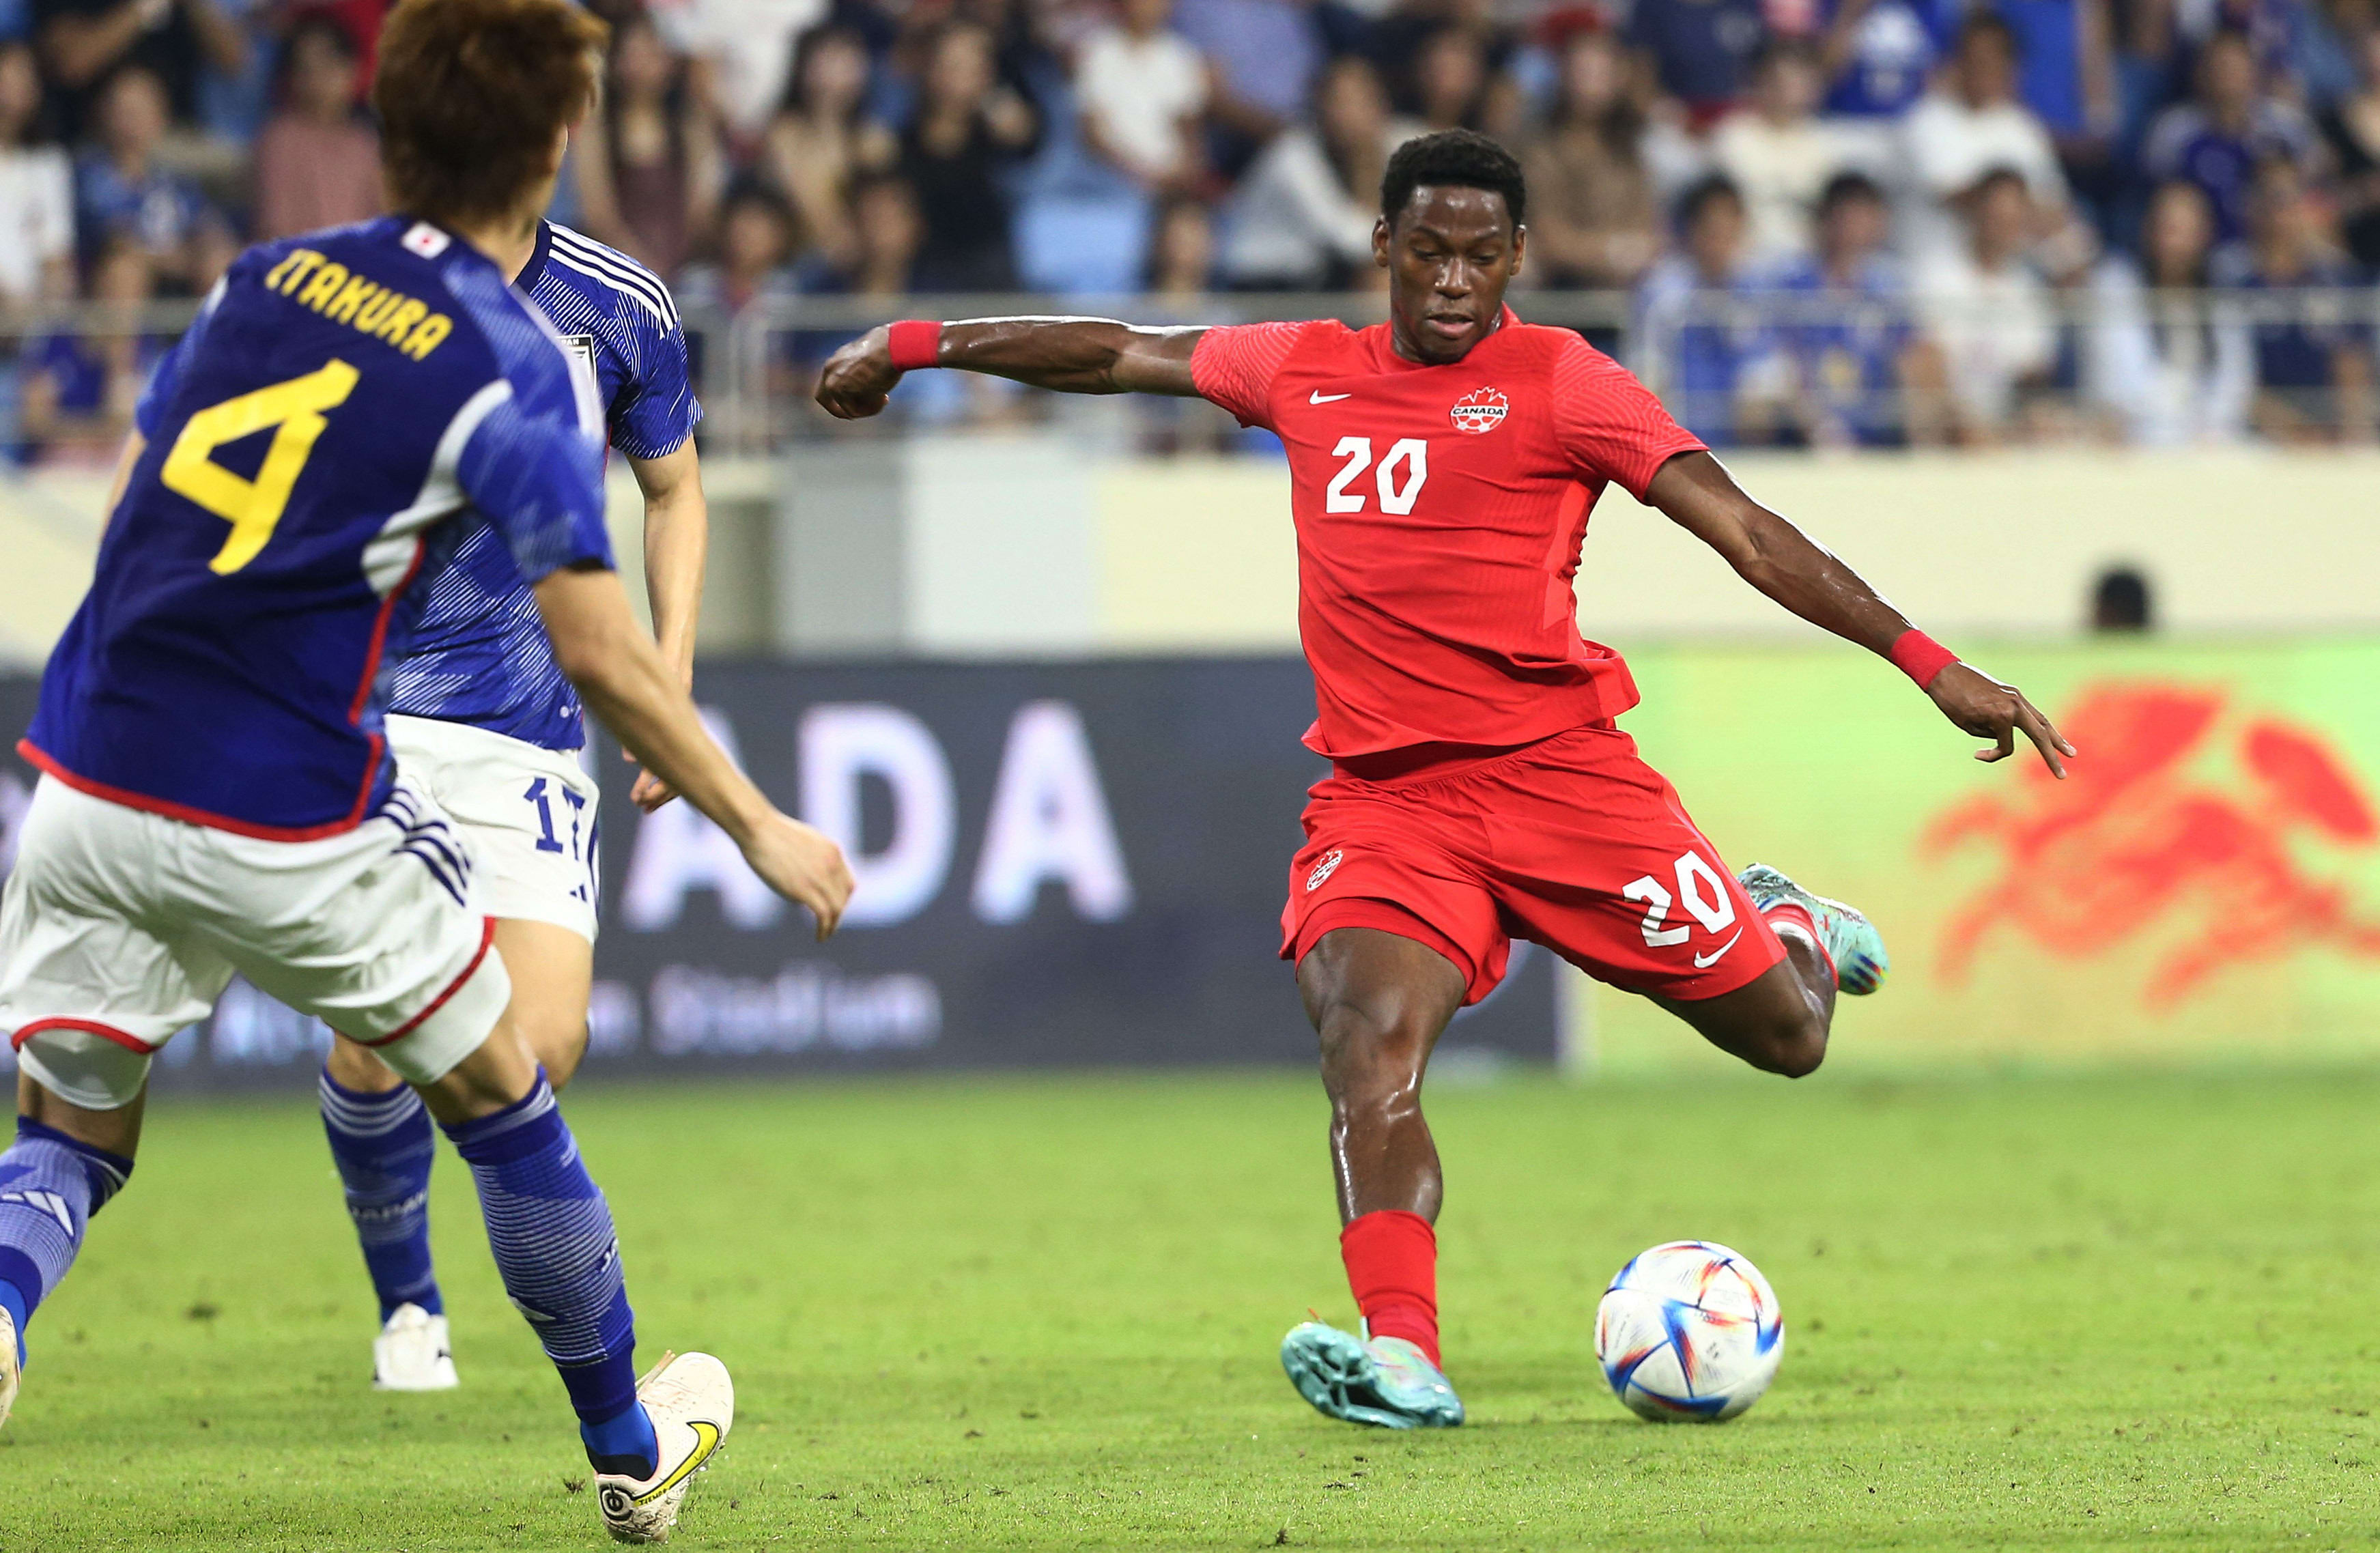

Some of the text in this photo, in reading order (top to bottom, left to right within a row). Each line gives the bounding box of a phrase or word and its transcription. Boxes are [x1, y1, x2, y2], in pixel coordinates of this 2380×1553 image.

[264, 248, 453, 362] ITAKURA
[1453, 408, 1503, 416] CANADA
[160, 357, 361, 576] 4
[1326, 436, 1428, 516] 20
[523, 777, 585, 861] 17
[584, 698, 1135, 934] ADA
[1621, 849, 1737, 948] 20
